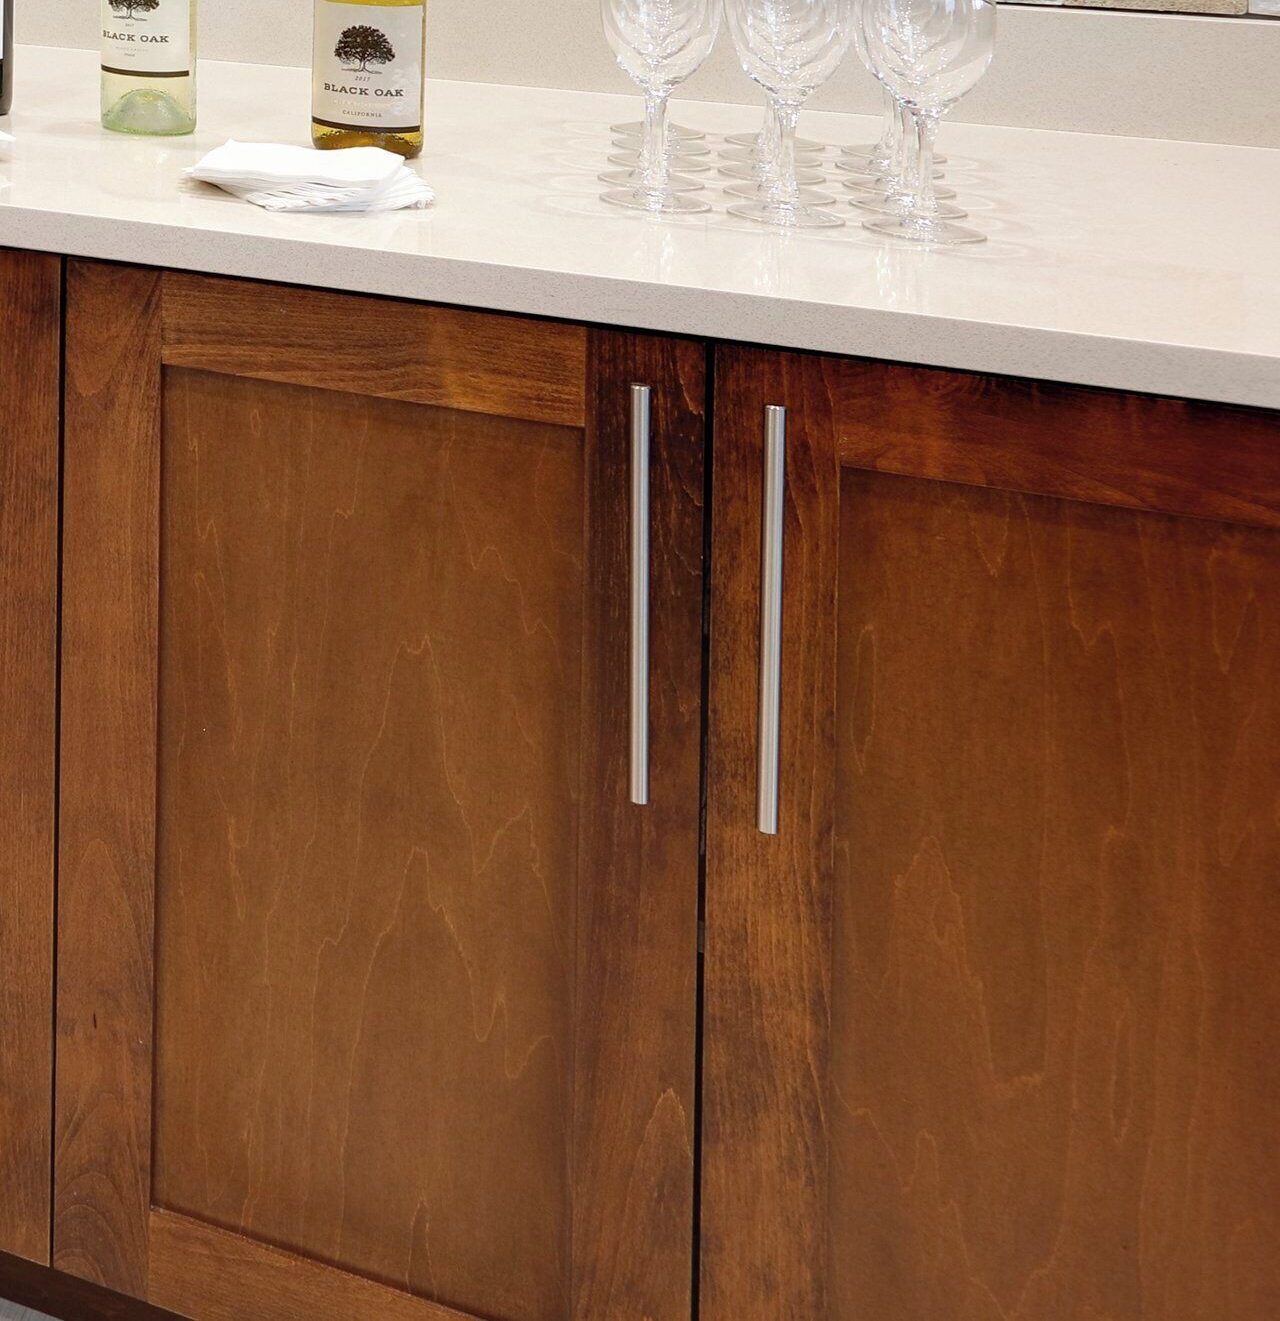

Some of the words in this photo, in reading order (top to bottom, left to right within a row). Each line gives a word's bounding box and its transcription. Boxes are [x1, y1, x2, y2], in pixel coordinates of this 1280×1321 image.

[103, 30, 136, 42] BLACK
[140, 35, 169, 43] OAK
[324, 83, 369, 96] BLACK
[374, 89, 404, 97] OAK
